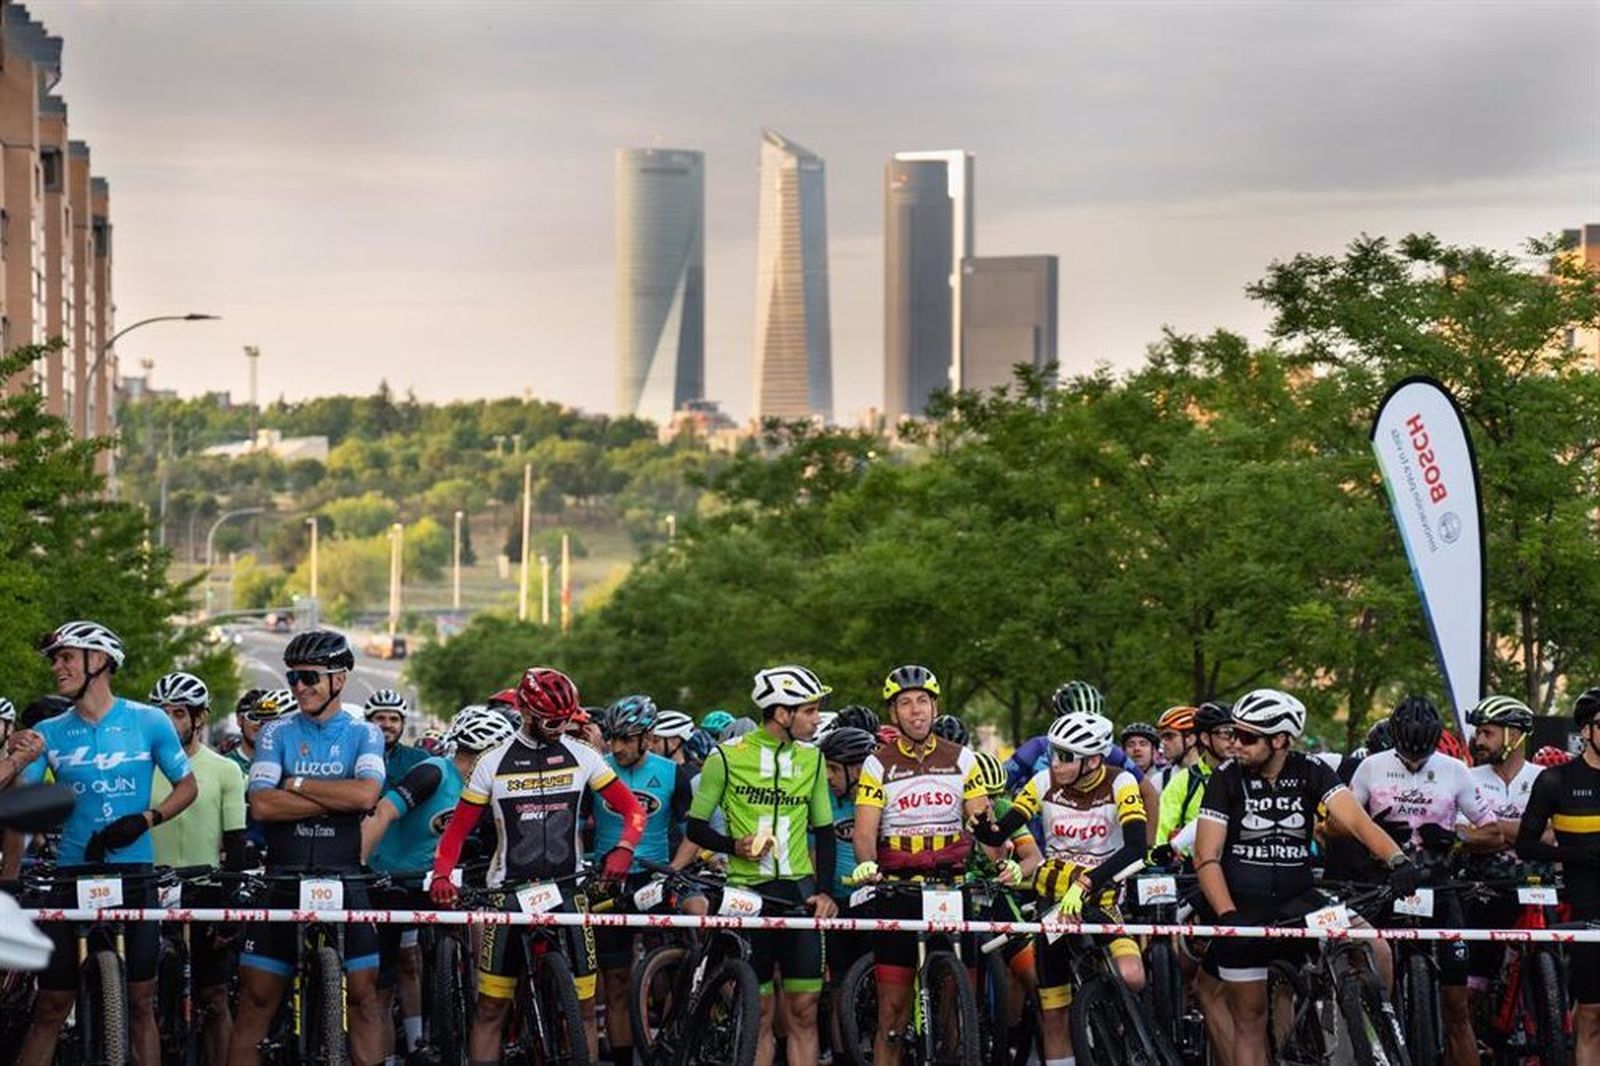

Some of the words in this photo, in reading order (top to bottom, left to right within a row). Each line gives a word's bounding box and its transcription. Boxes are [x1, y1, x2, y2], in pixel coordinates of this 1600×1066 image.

[295, 761, 344, 776] LUZCO
[898, 791, 954, 810] HUESO
[1244, 796, 1305, 812] ROCK
[1231, 844, 1309, 860] SIERRA
[88, 886, 111, 900] 318
[310, 888, 333, 901] 190
[730, 897, 754, 912] 290
[938, 901, 948, 913] 4
